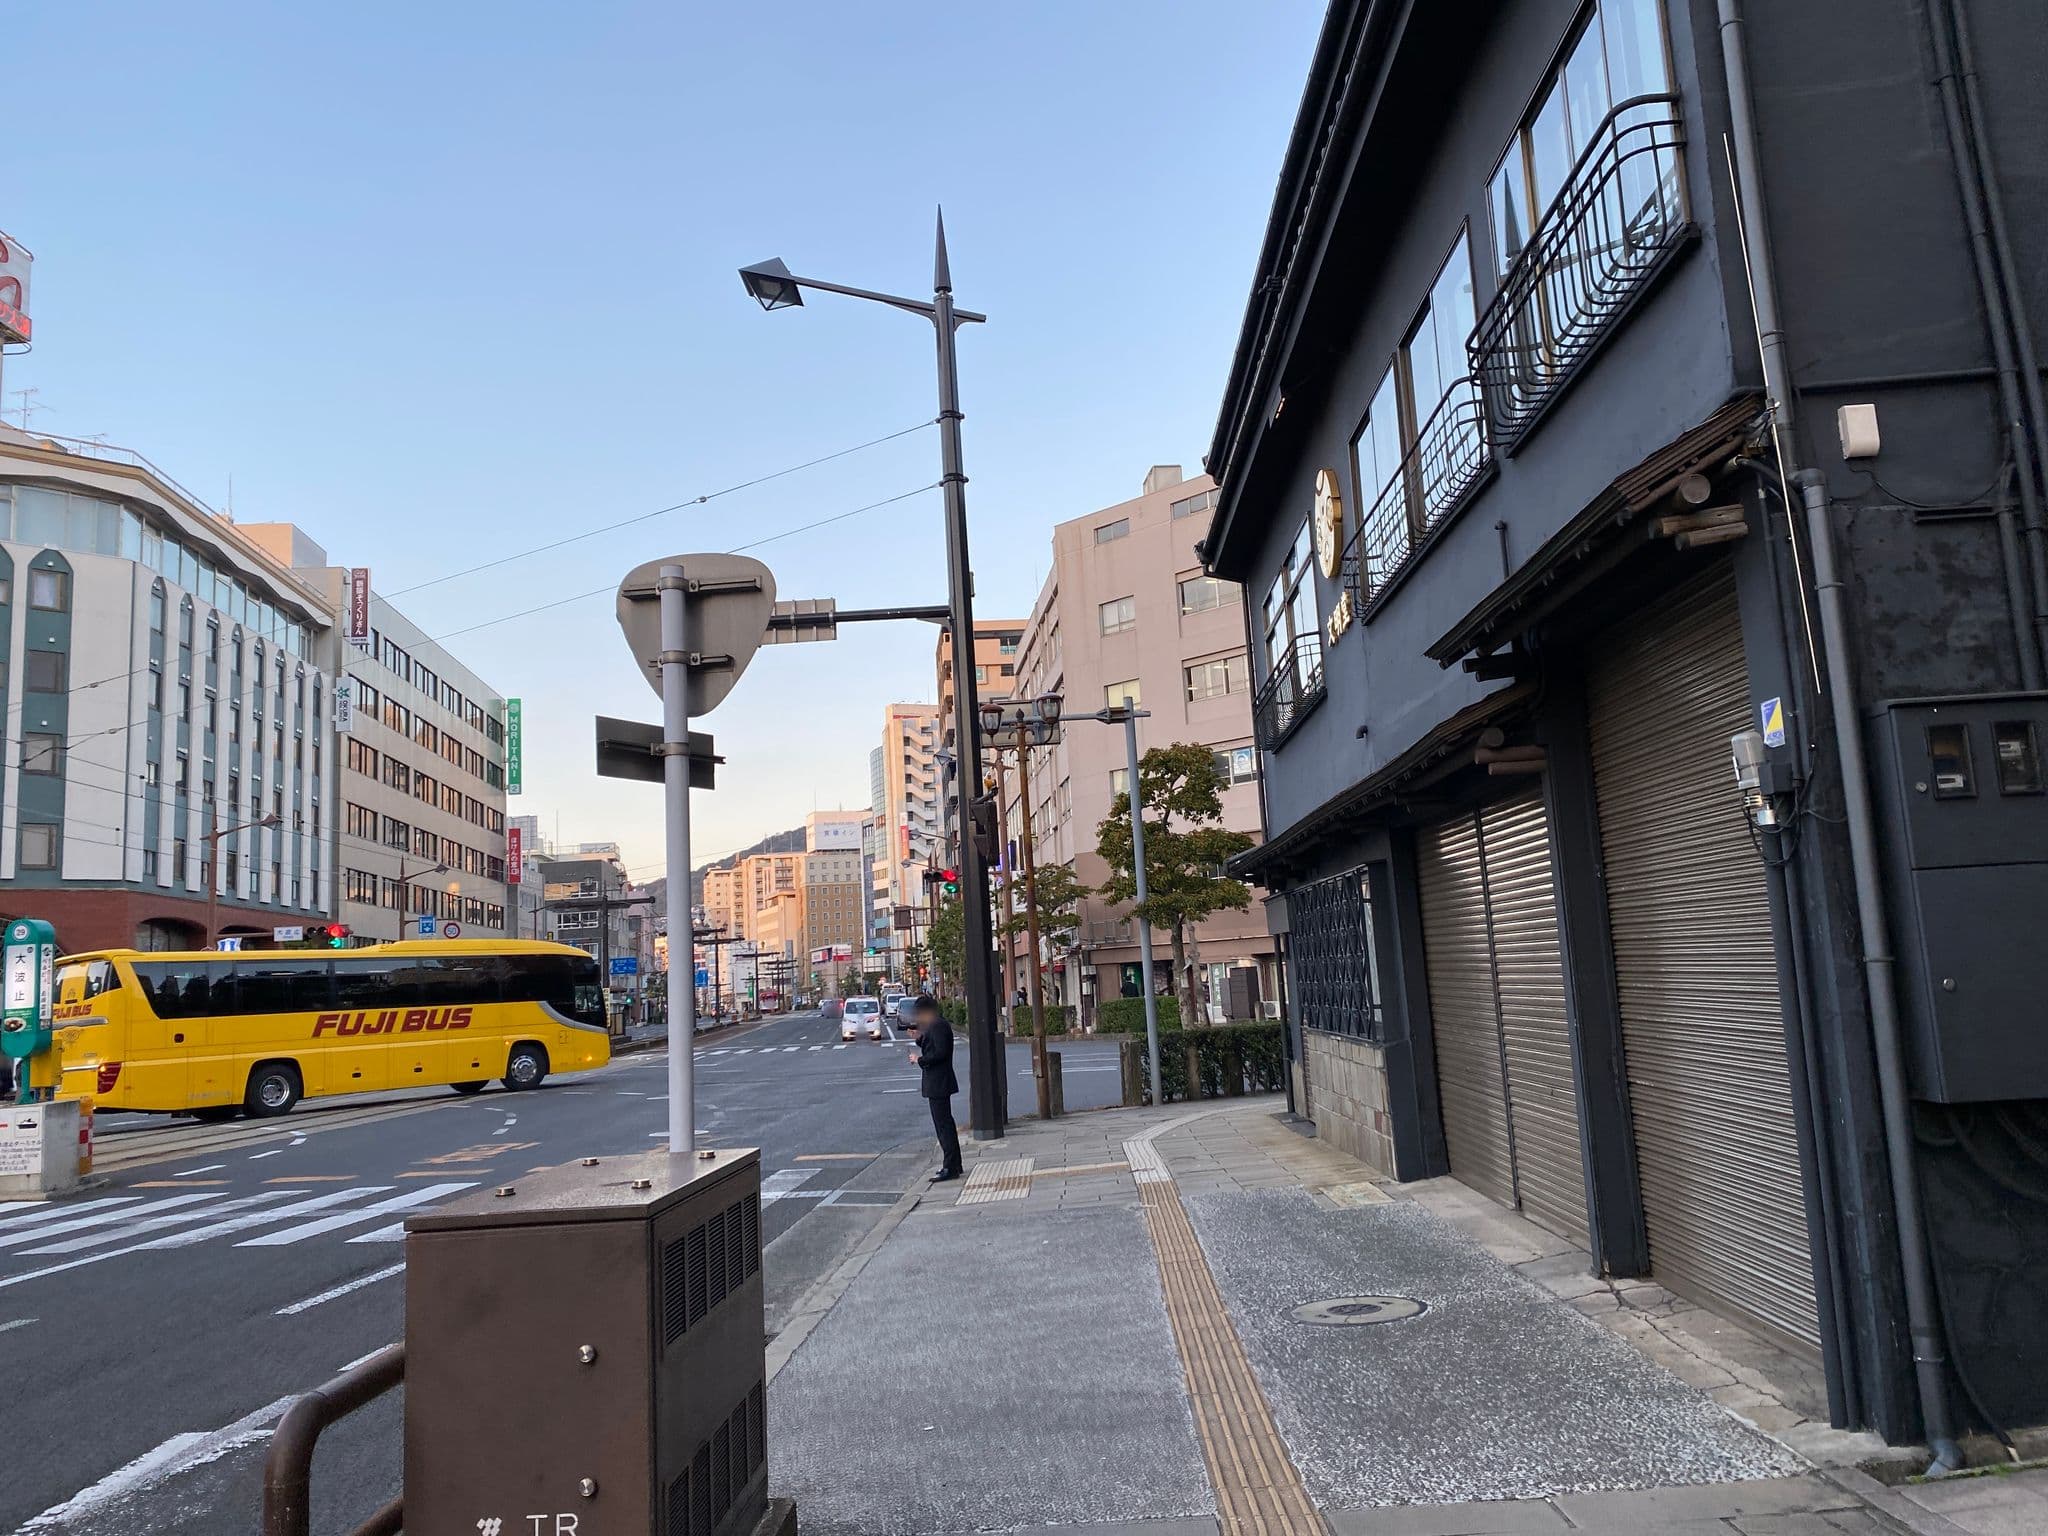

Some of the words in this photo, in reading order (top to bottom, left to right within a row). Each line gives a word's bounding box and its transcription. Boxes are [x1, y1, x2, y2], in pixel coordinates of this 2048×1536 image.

[510, 716, 518, 777] MORITANI
[447, 927, 457, 935] 50
[15, 952, 26, 1001] 大波止
[72, 1004, 92, 1016] BUS
[312, 1010, 398, 1038] FUJI
[400, 1007, 473, 1033] BUS
